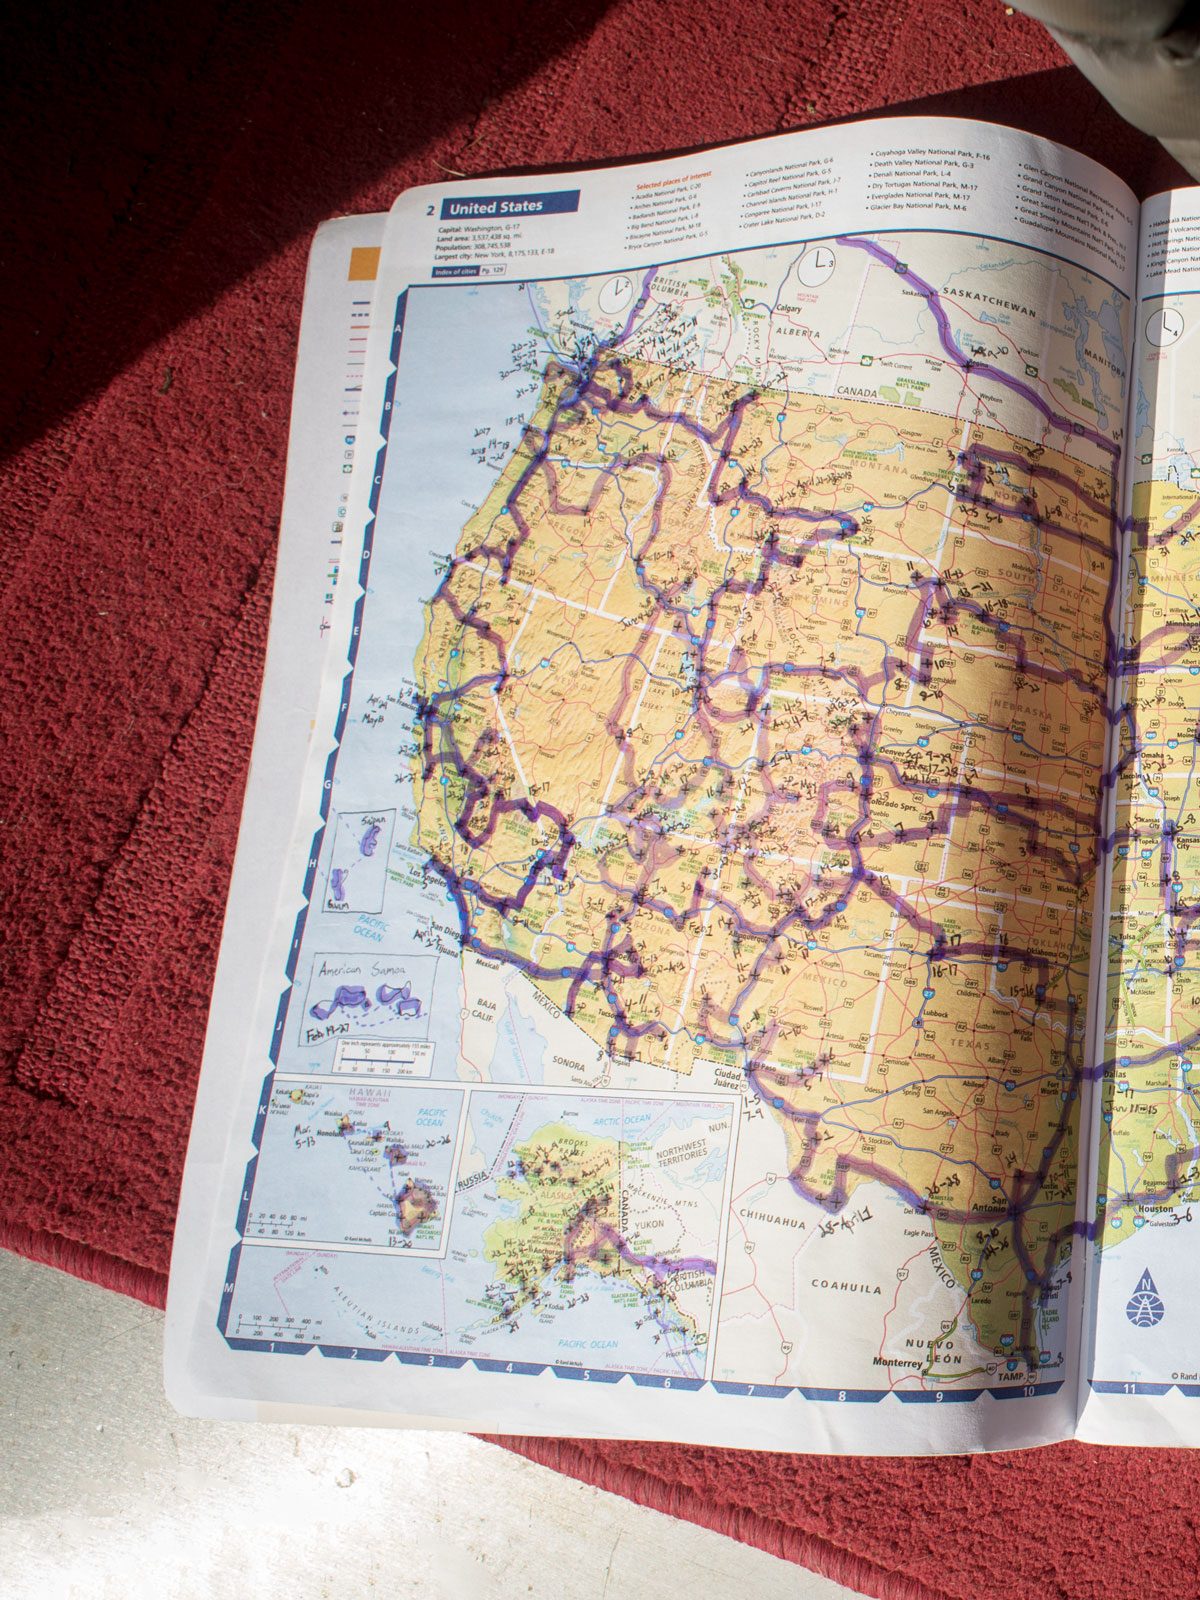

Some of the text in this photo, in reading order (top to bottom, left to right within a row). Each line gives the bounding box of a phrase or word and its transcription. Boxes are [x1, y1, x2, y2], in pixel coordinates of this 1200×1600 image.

[875, 149, 905, 157] Cuyahoga
[636, 182, 661, 190] Selected
[690, 171, 711, 180] interest
[426, 200, 543, 216] 2 United States
[943, 286, 1036, 317] SASKATCHEWAN
[777, 304, 801, 313] Calgary
[837, 385, 877, 398] CANADA
[349, 1088, 391, 1097] HAWAII
[656, 1139, 706, 1159] NORTHWEST
[659, 1148, 708, 1167] TERRITORIES
[457, 1171, 487, 1190] RUSSIA
[1139, 1204, 1174, 1213] Houston
[739, 1208, 806, 1229] CHIHUAHUA
[635, 1220, 664, 1230] YUKON
[811, 1279, 881, 1295] COAHUILA
[906, 1338, 954, 1349] NUEVO
[873, 1358, 922, 1369] Monterrey
[926, 1353, 961, 1364] LEÓN
[1180, 1372, 1198, 1381] Rand
[839, 1391, 846, 1401] 8
[936, 1391, 943, 1402] 9
